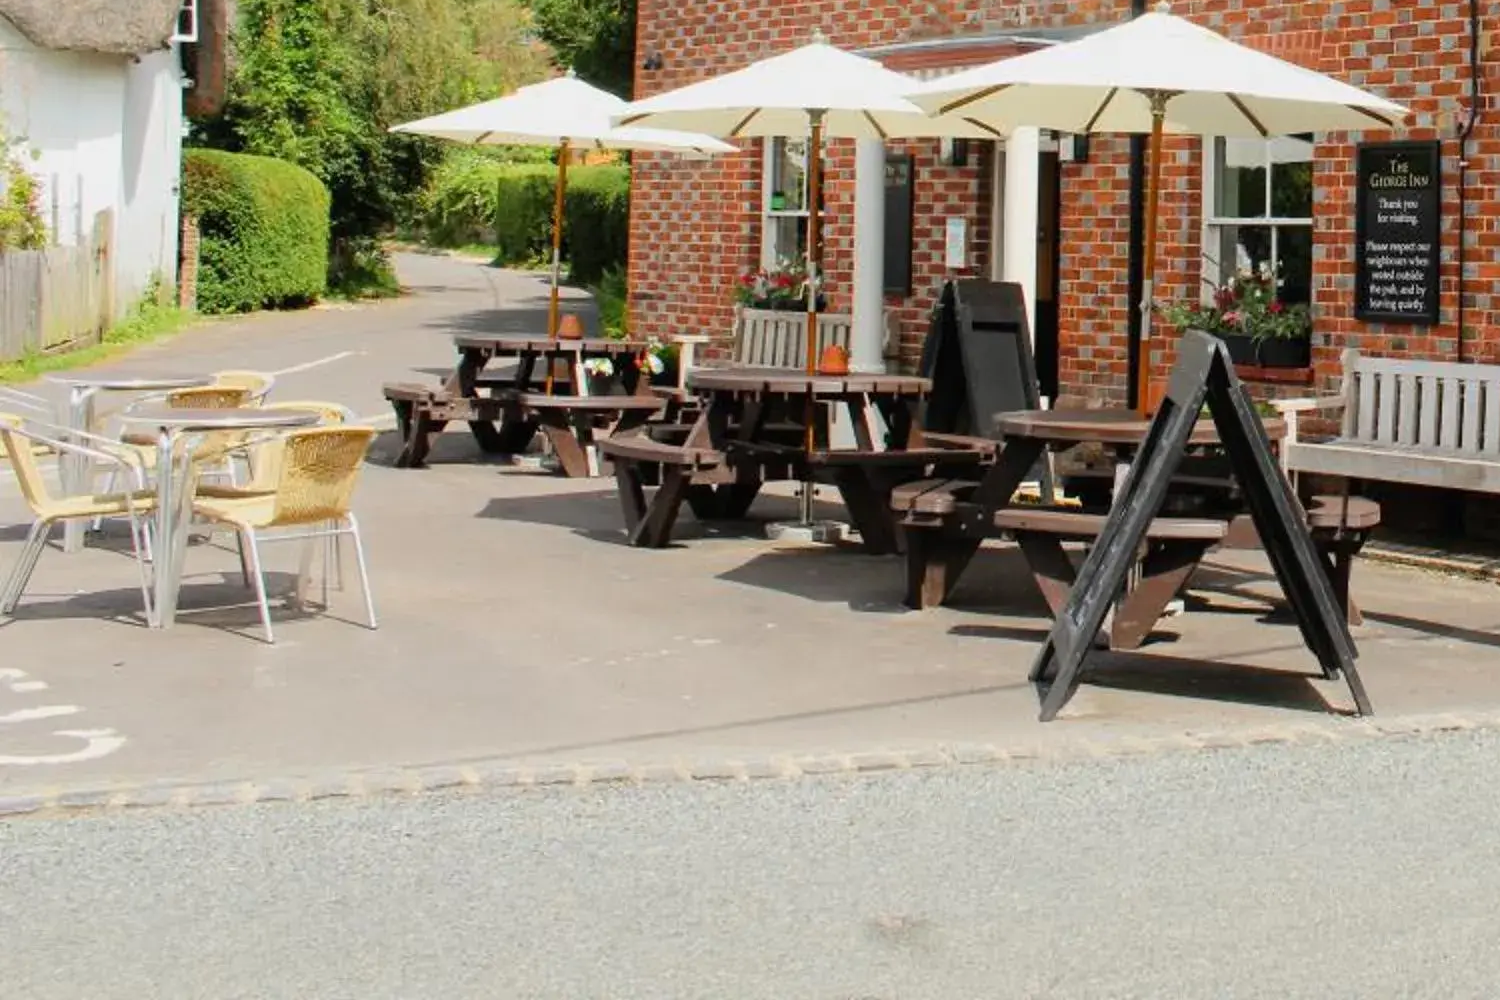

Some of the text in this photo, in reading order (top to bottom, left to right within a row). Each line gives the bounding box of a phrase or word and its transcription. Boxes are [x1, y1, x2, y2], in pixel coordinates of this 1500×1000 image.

[1369, 172, 1407, 188] GEORGE
[1378, 197, 1418, 212] Thank you
[1377, 212, 1388, 223] for
[1365, 241, 1388, 251] Please
[1390, 242, 1416, 255] respect
[1408, 256, 1429, 266] when
